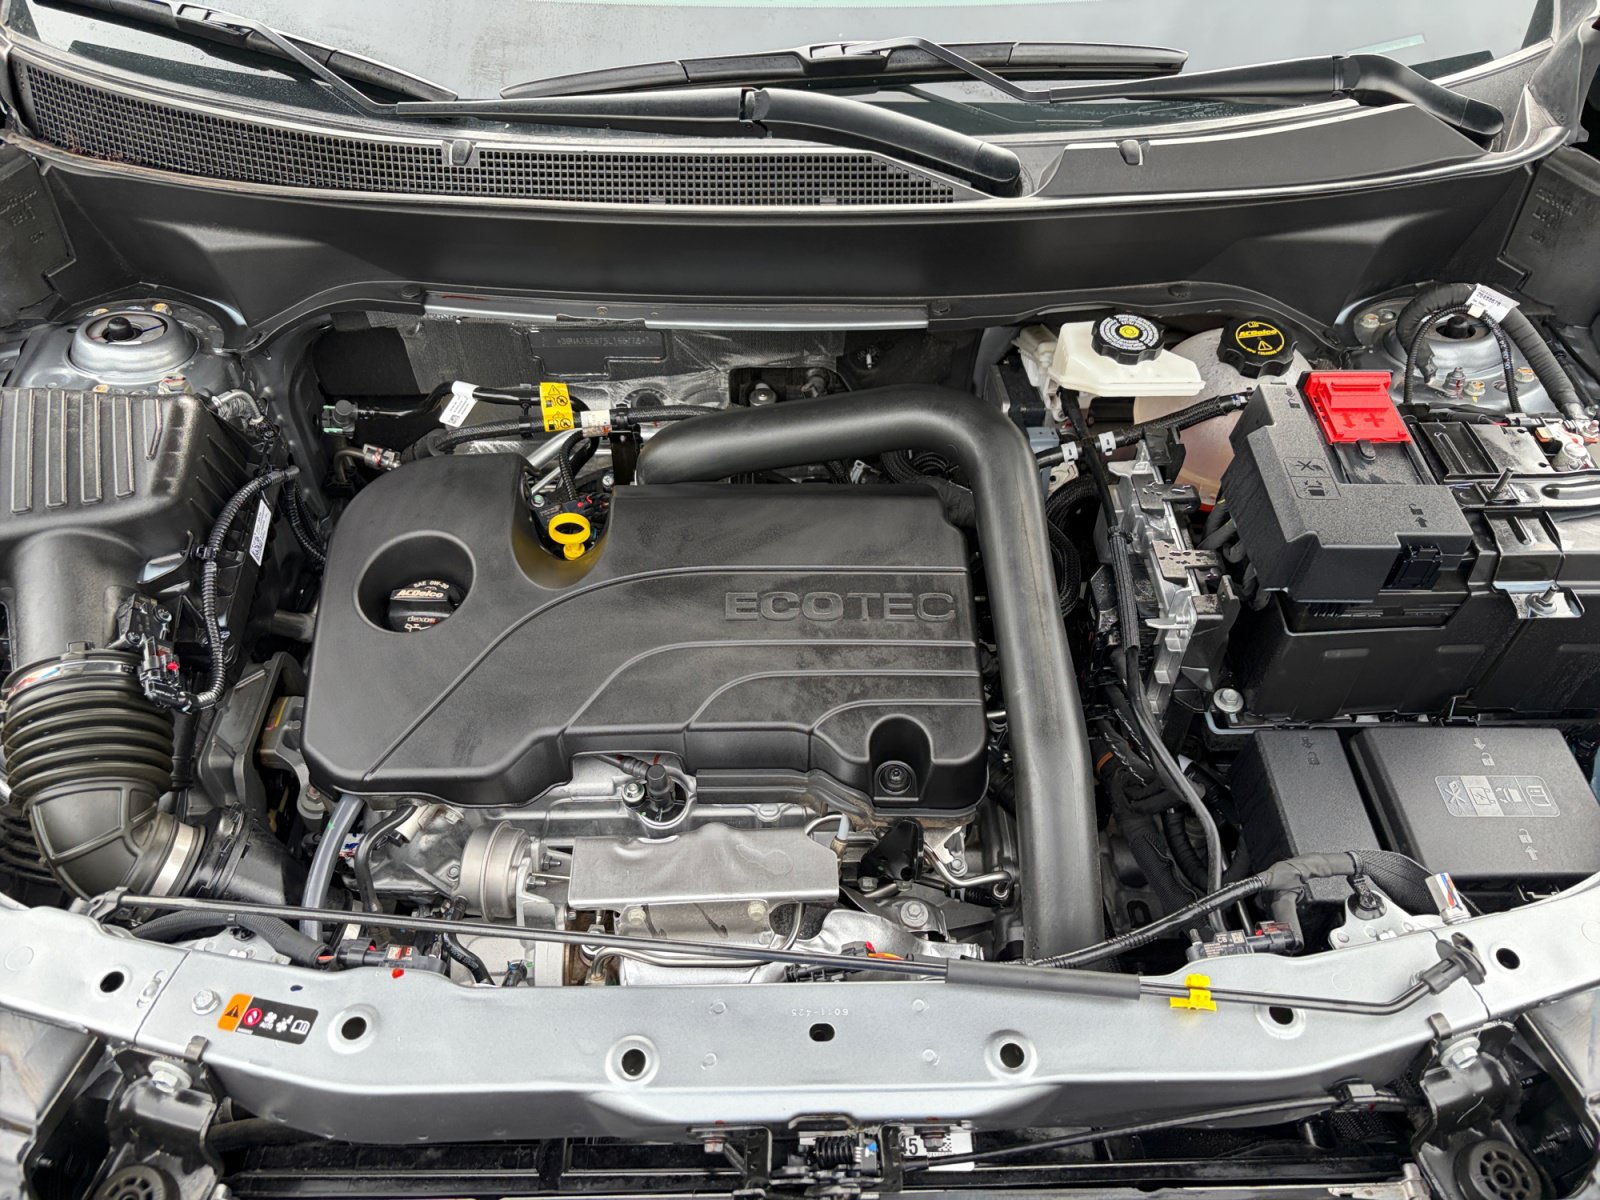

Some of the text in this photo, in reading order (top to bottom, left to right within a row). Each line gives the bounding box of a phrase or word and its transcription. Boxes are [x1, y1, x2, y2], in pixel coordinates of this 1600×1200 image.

[1238, 330, 1278, 339] ACDelco
[395, 589, 444, 598] ACDelco
[725, 592, 956, 622] ECOTEC
